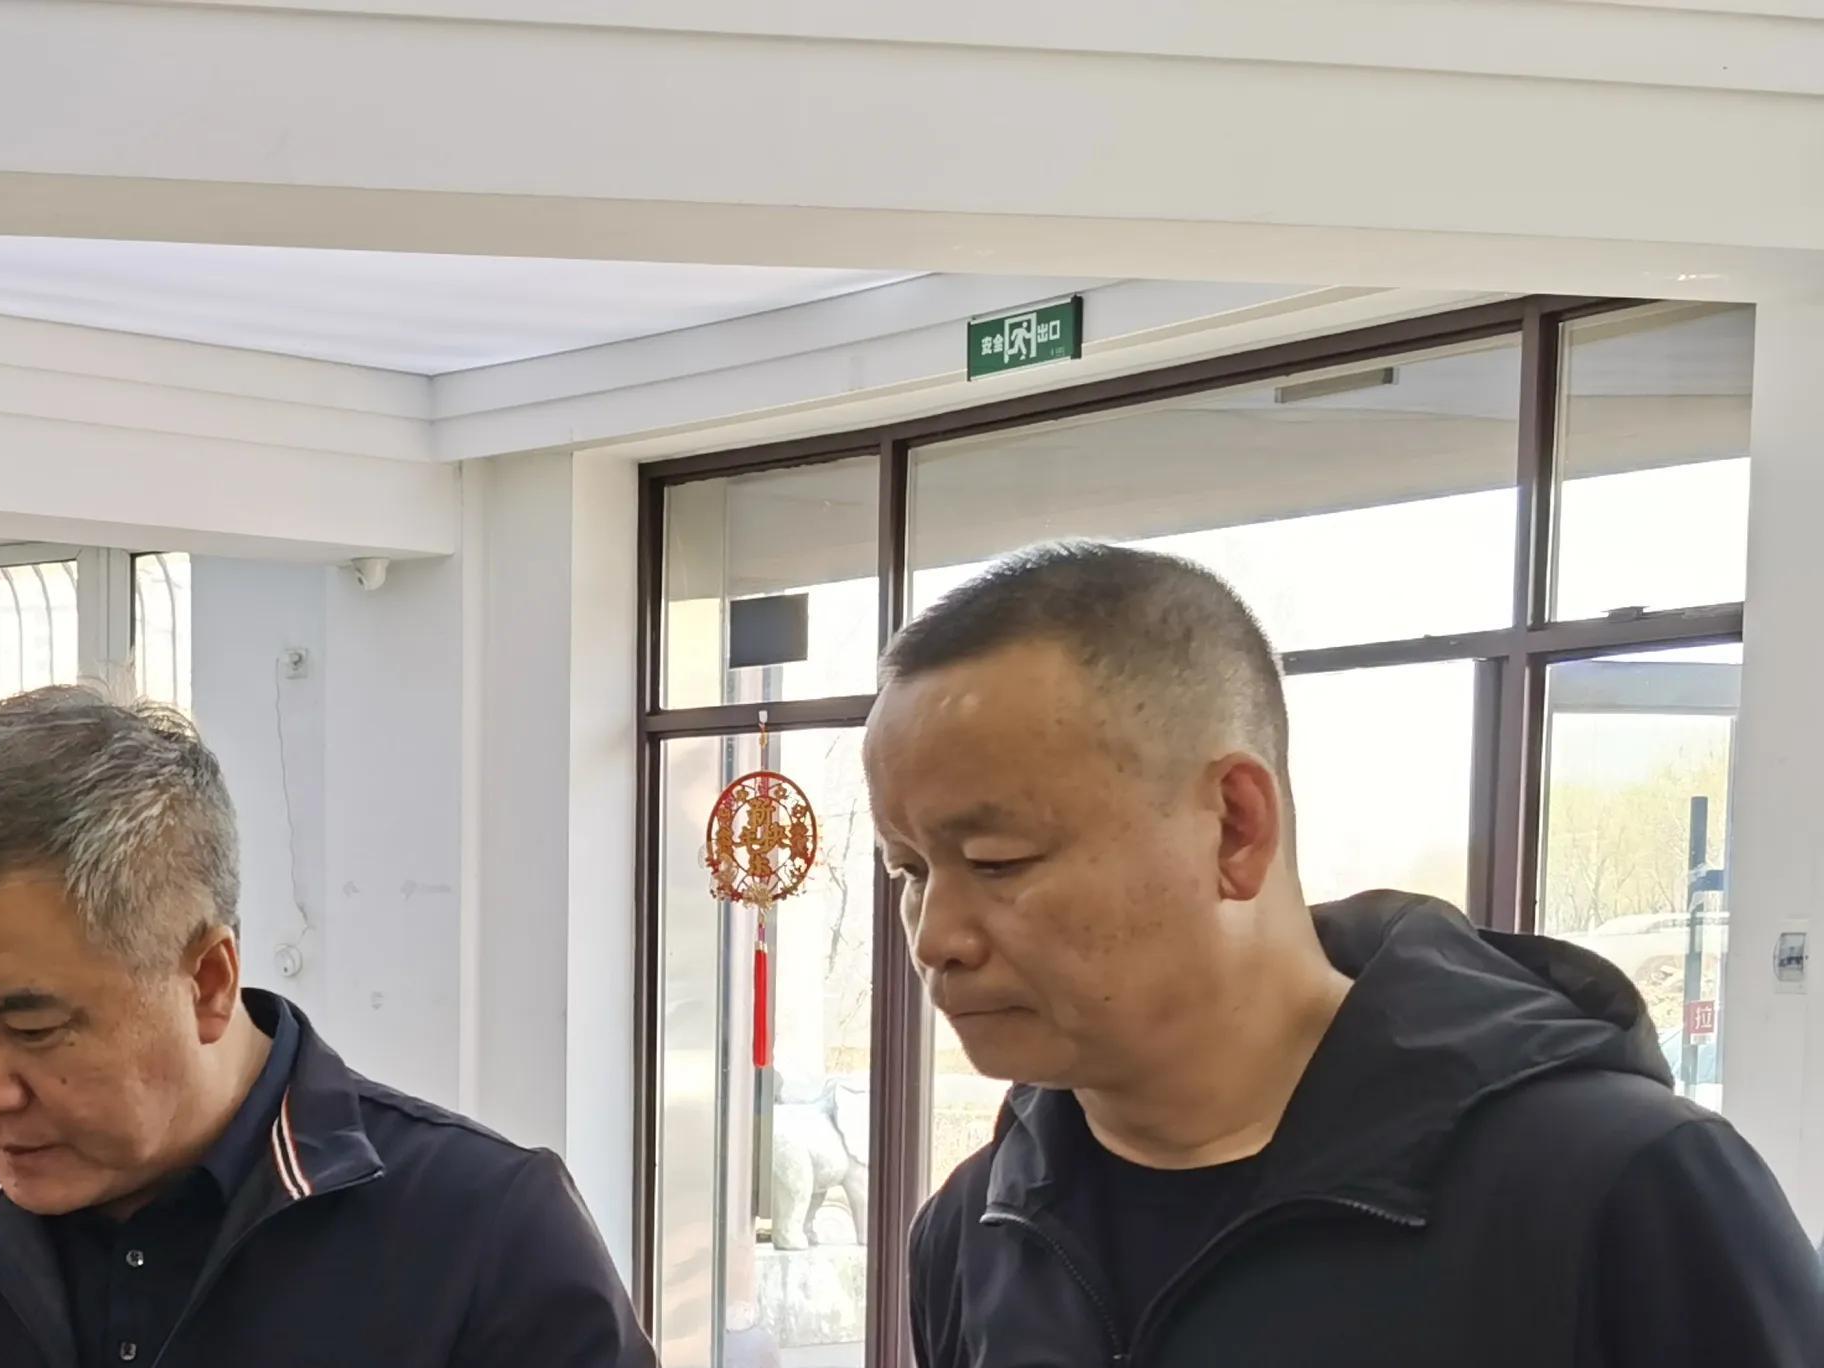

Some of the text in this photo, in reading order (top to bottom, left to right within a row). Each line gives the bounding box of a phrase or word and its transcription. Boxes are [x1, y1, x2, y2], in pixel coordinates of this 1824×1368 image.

[981, 320, 1061, 355] 安全 出口
[1695, 1006, 1713, 1030] 拉
